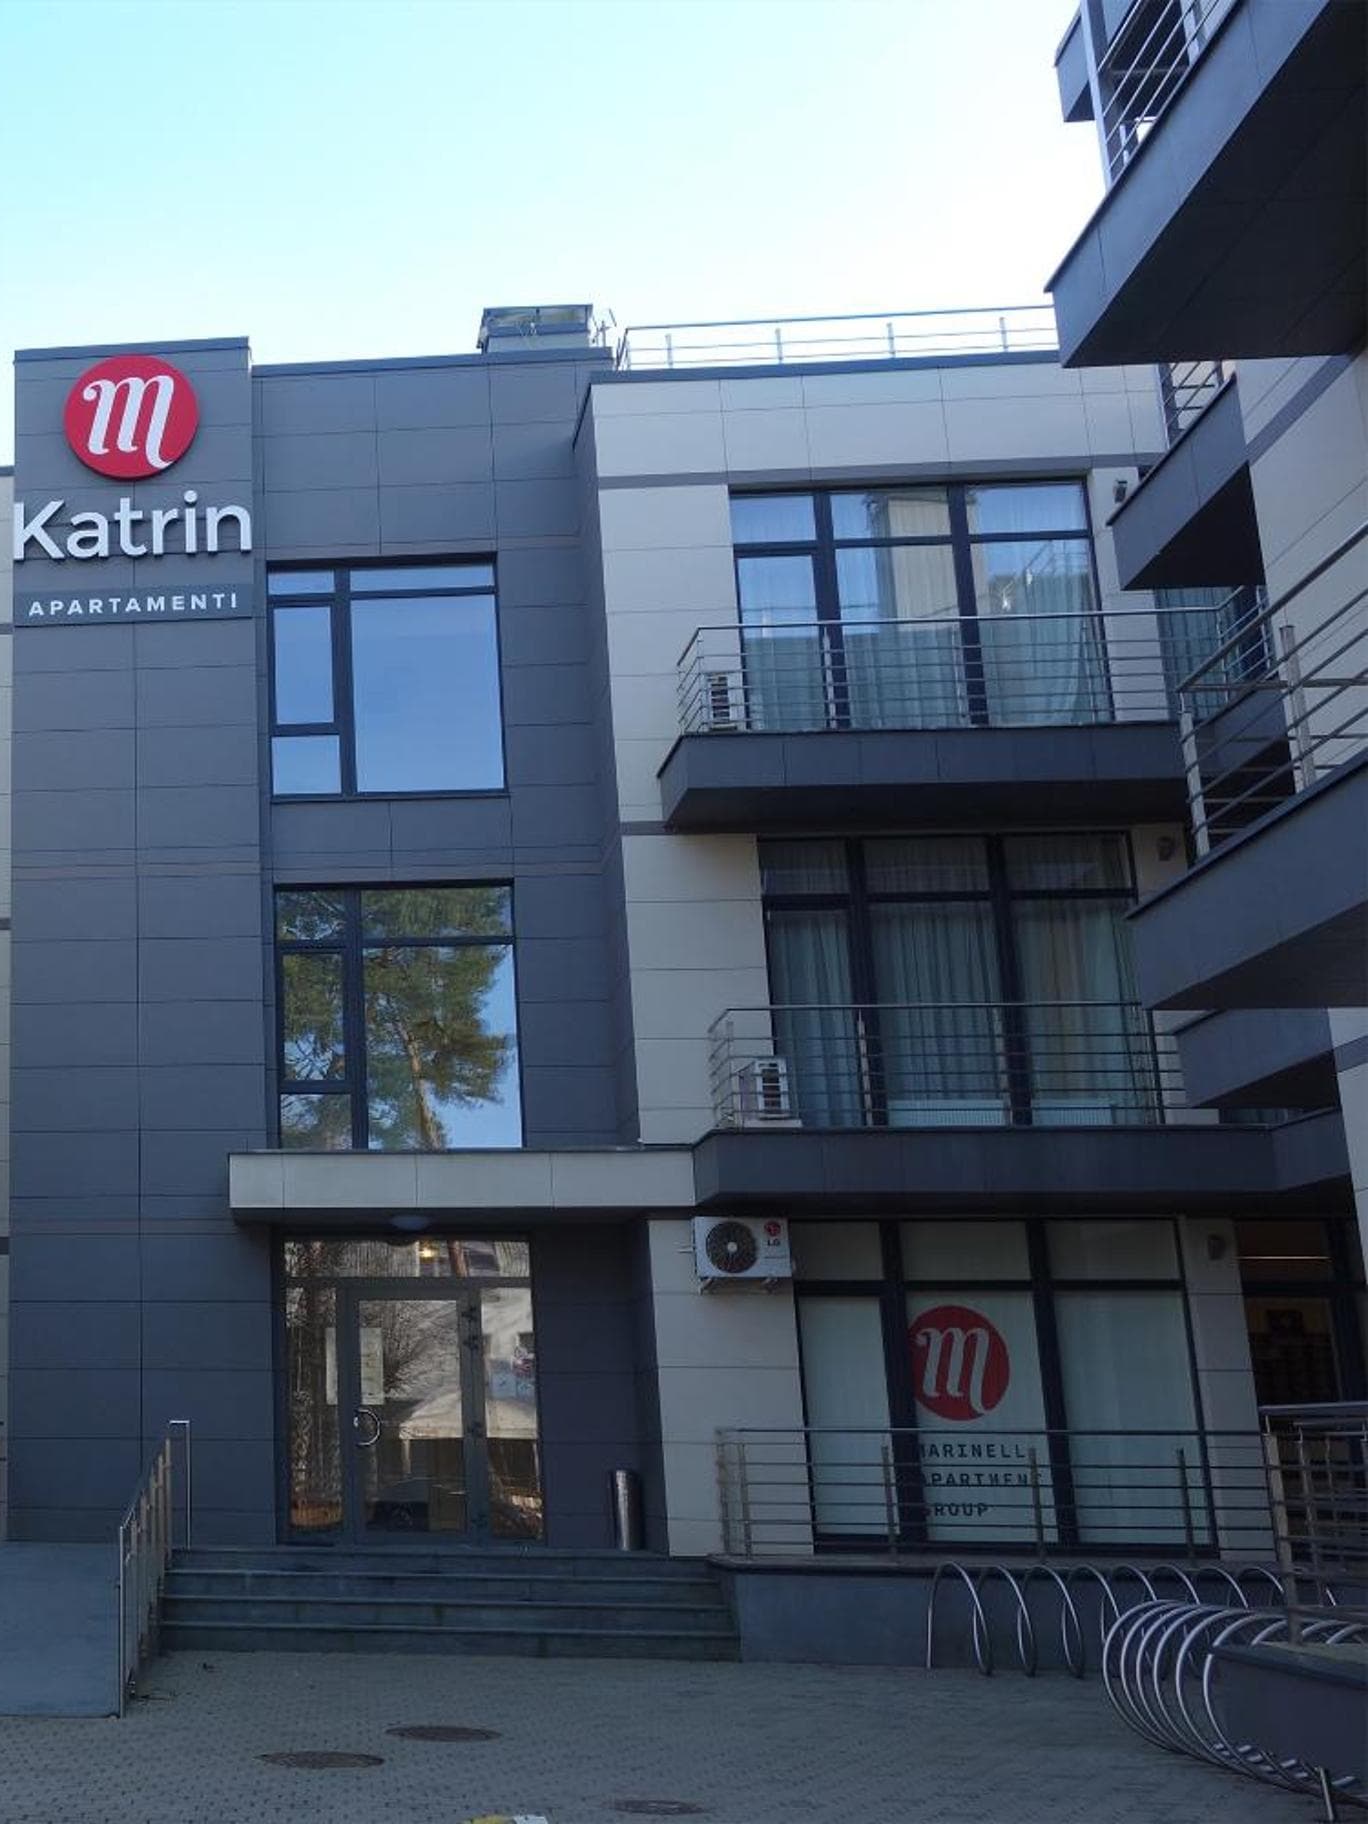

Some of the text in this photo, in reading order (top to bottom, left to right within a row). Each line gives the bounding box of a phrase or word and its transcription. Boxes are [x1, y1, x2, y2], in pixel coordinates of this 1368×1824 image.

[13, 490, 252, 561] Katrin
[29, 592, 237, 617] APARTAMENTI
[926, 1502, 988, 1517] ROUP
